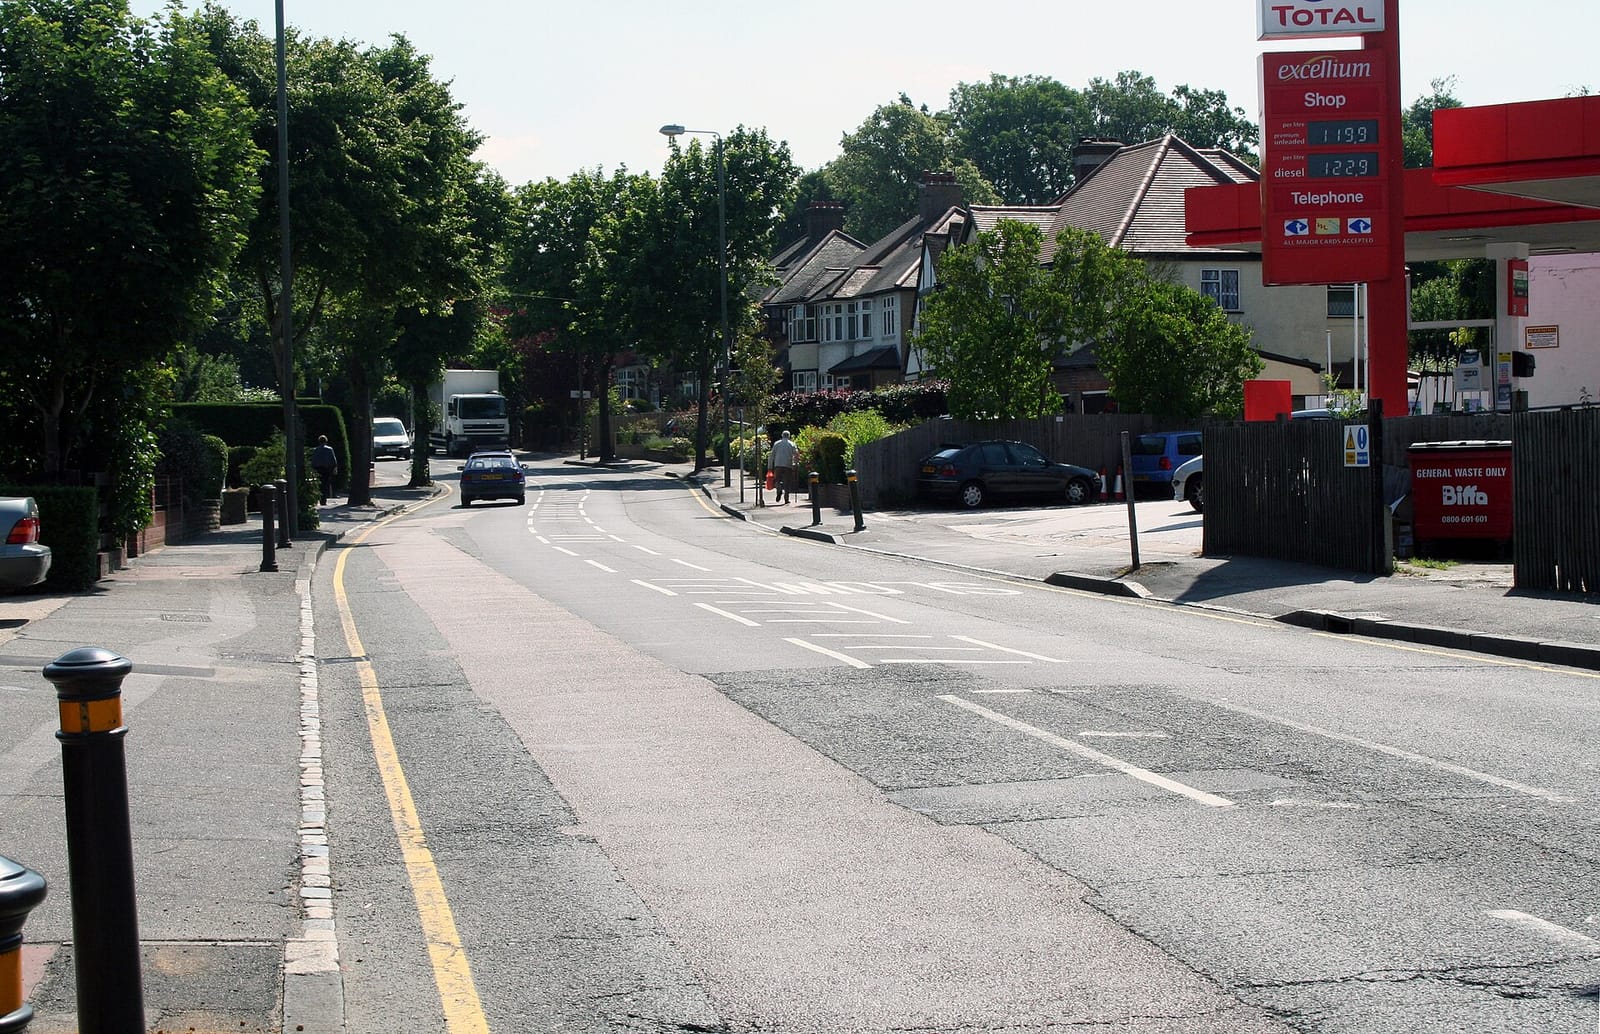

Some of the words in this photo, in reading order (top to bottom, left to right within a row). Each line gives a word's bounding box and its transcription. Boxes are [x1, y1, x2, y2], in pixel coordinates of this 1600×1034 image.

[1271, 5, 1376, 27] TOTAL
[1278, 59, 1372, 80] excellium
[1304, 92, 1346, 109] Shop
[1274, 167, 1305, 178] diesel
[1291, 191, 1364, 206] Telephone
[1416, 469, 1452, 478] GENERAL
[1454, 467, 1483, 478] WASTE
[1485, 466, 1507, 477] ONLY
[1442, 485, 1488, 505] Biffa
[1441, 515, 1460, 524] 0800
